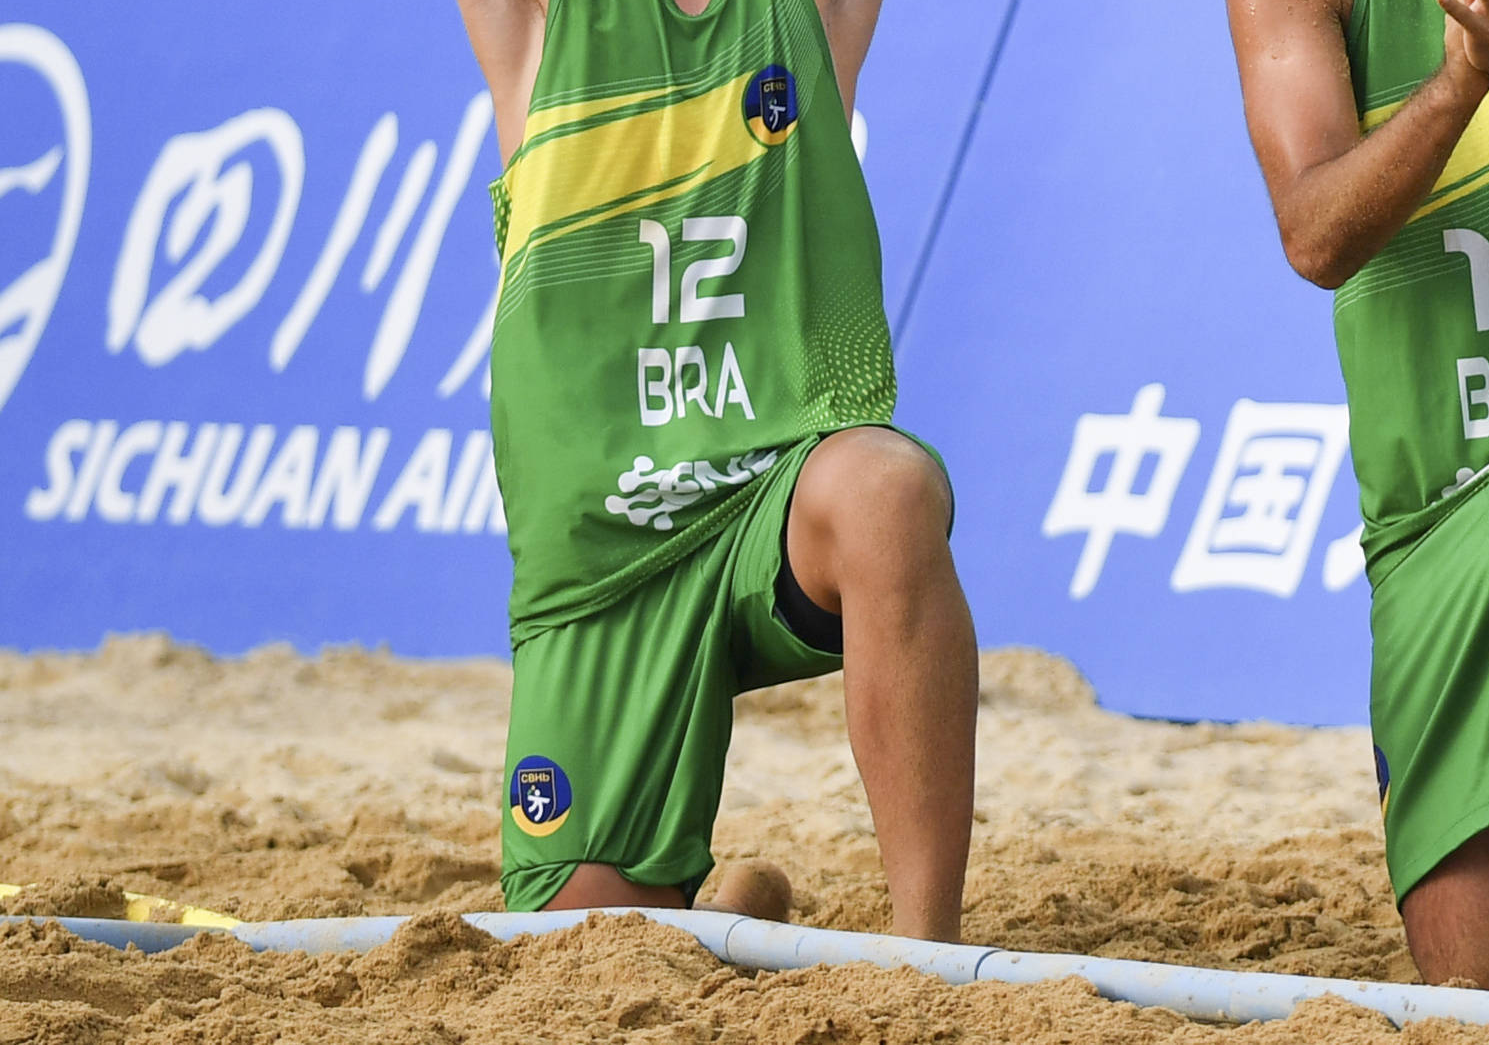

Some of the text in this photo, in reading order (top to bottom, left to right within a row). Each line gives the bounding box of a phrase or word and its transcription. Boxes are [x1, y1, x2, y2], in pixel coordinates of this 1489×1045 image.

[105, 88, 494, 402] 四川
[638, 215, 748, 324] 12
[638, 341, 757, 427] BRA
[26, 418, 391, 531] SICHUAN
